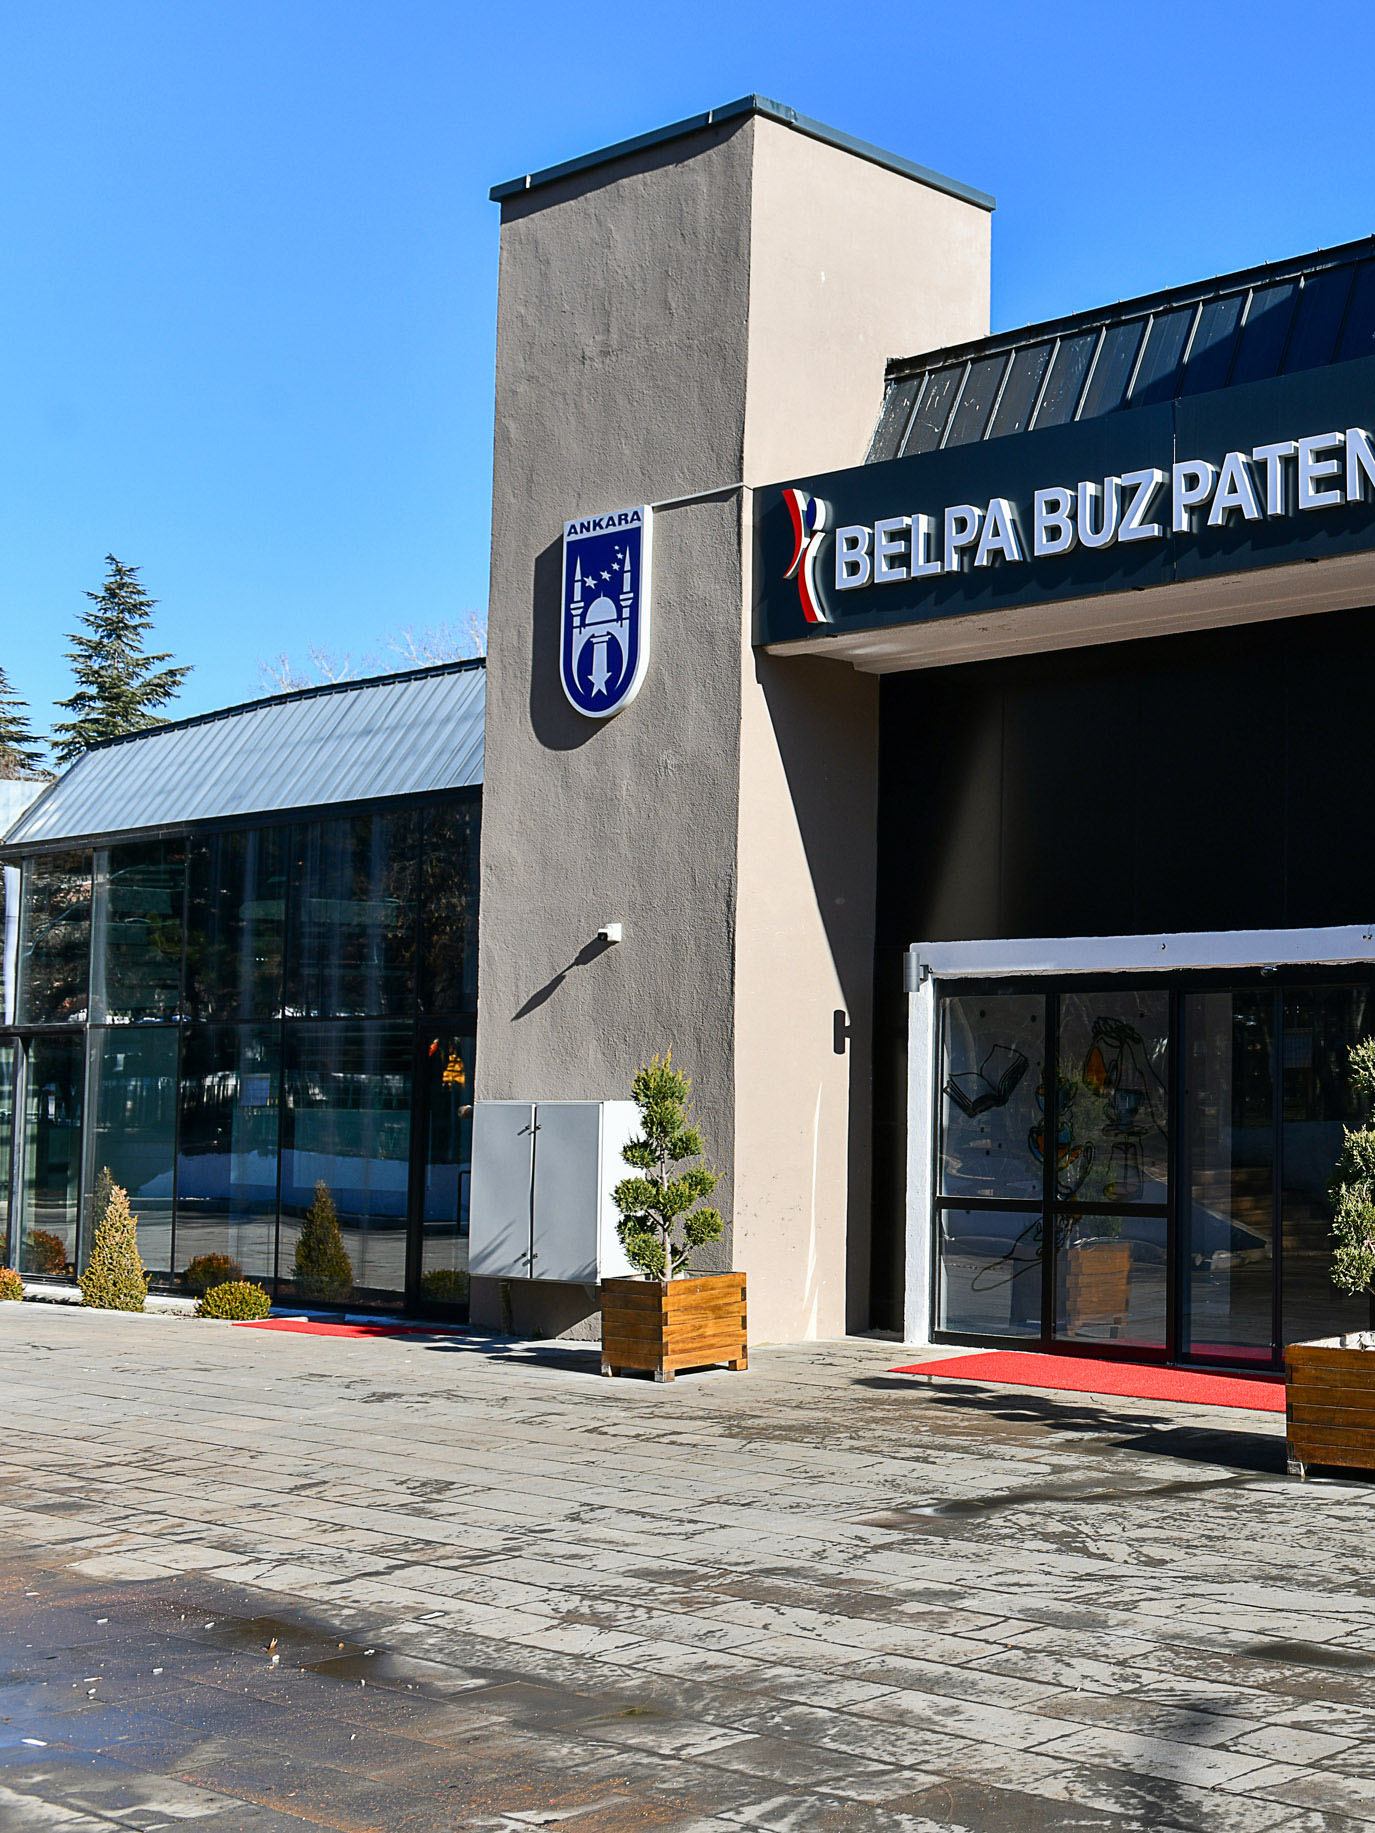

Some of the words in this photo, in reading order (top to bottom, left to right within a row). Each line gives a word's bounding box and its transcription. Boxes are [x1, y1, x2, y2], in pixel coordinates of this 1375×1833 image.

[567, 510, 641, 537] ANKARA
[834, 498, 1020, 590] BELPA
[1034, 468, 1168, 556] BUZ
